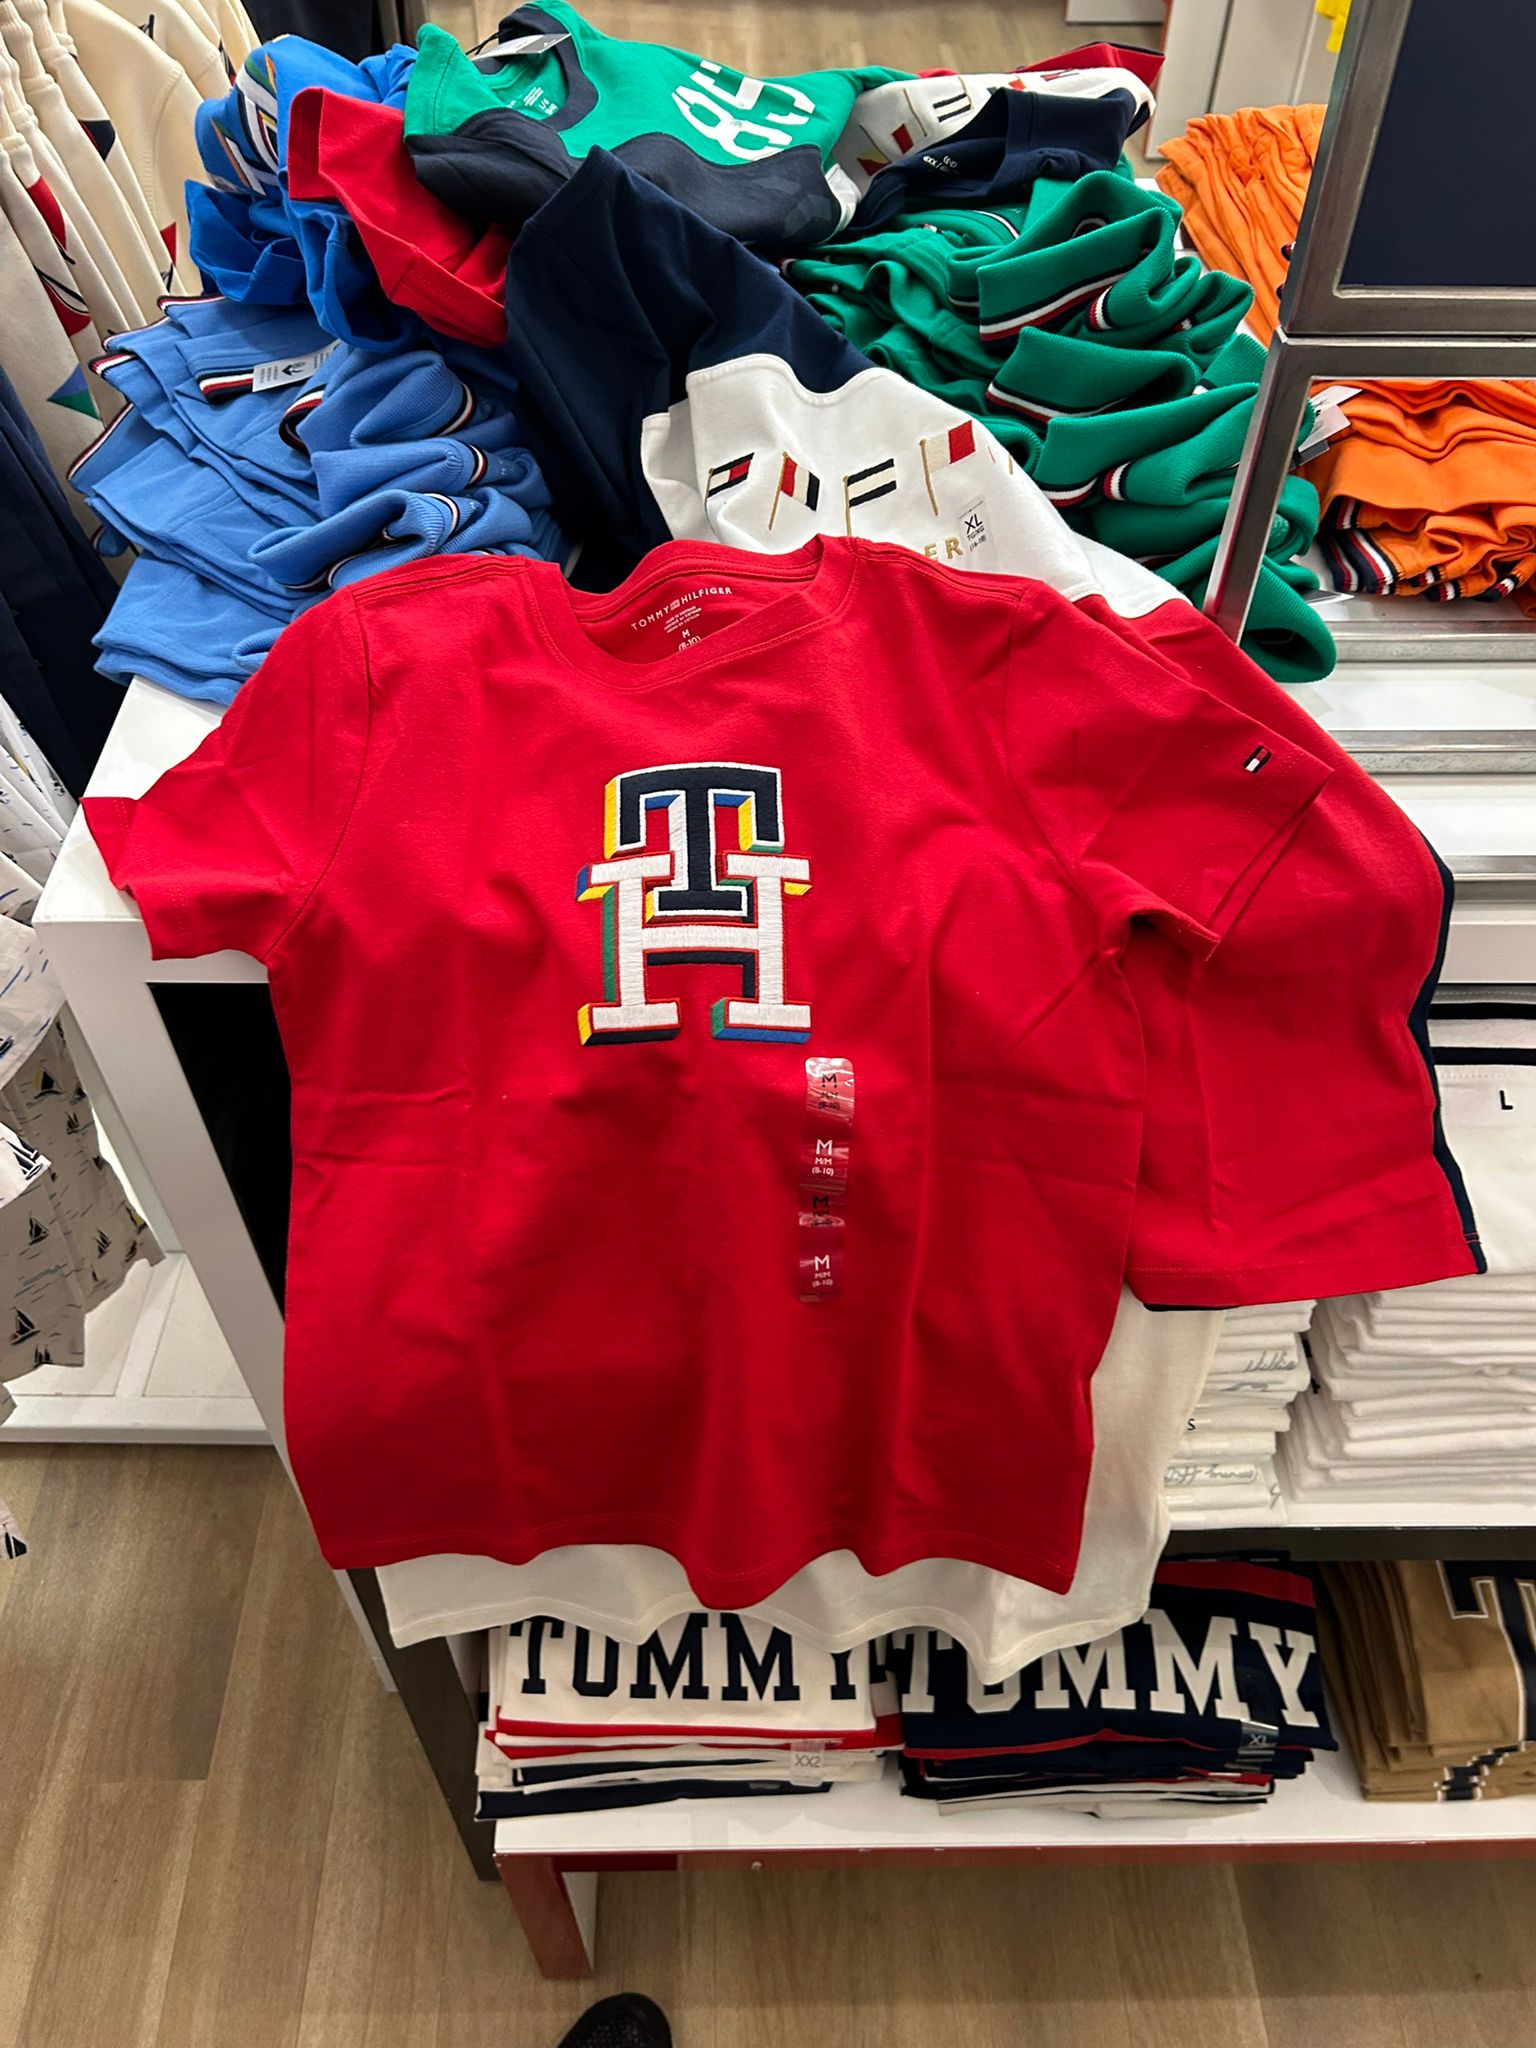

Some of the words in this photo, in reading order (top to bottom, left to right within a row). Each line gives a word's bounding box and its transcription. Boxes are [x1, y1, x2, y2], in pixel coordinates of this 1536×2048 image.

[964, 513, 983, 535] XL
[631, 605, 669, 631] TOMMY
[681, 586, 732, 605] HILFIGER
[681, 628, 690, 639] M
[1499, 1089, 1513, 1110] L
[816, 1139, 832, 1156] M
[815, 1157, 832, 1166] M/M
[812, 1166, 834, 1177] (8-10)
[814, 1254, 830, 1271] M
[892, 1608, 1320, 1728] TOMMY
